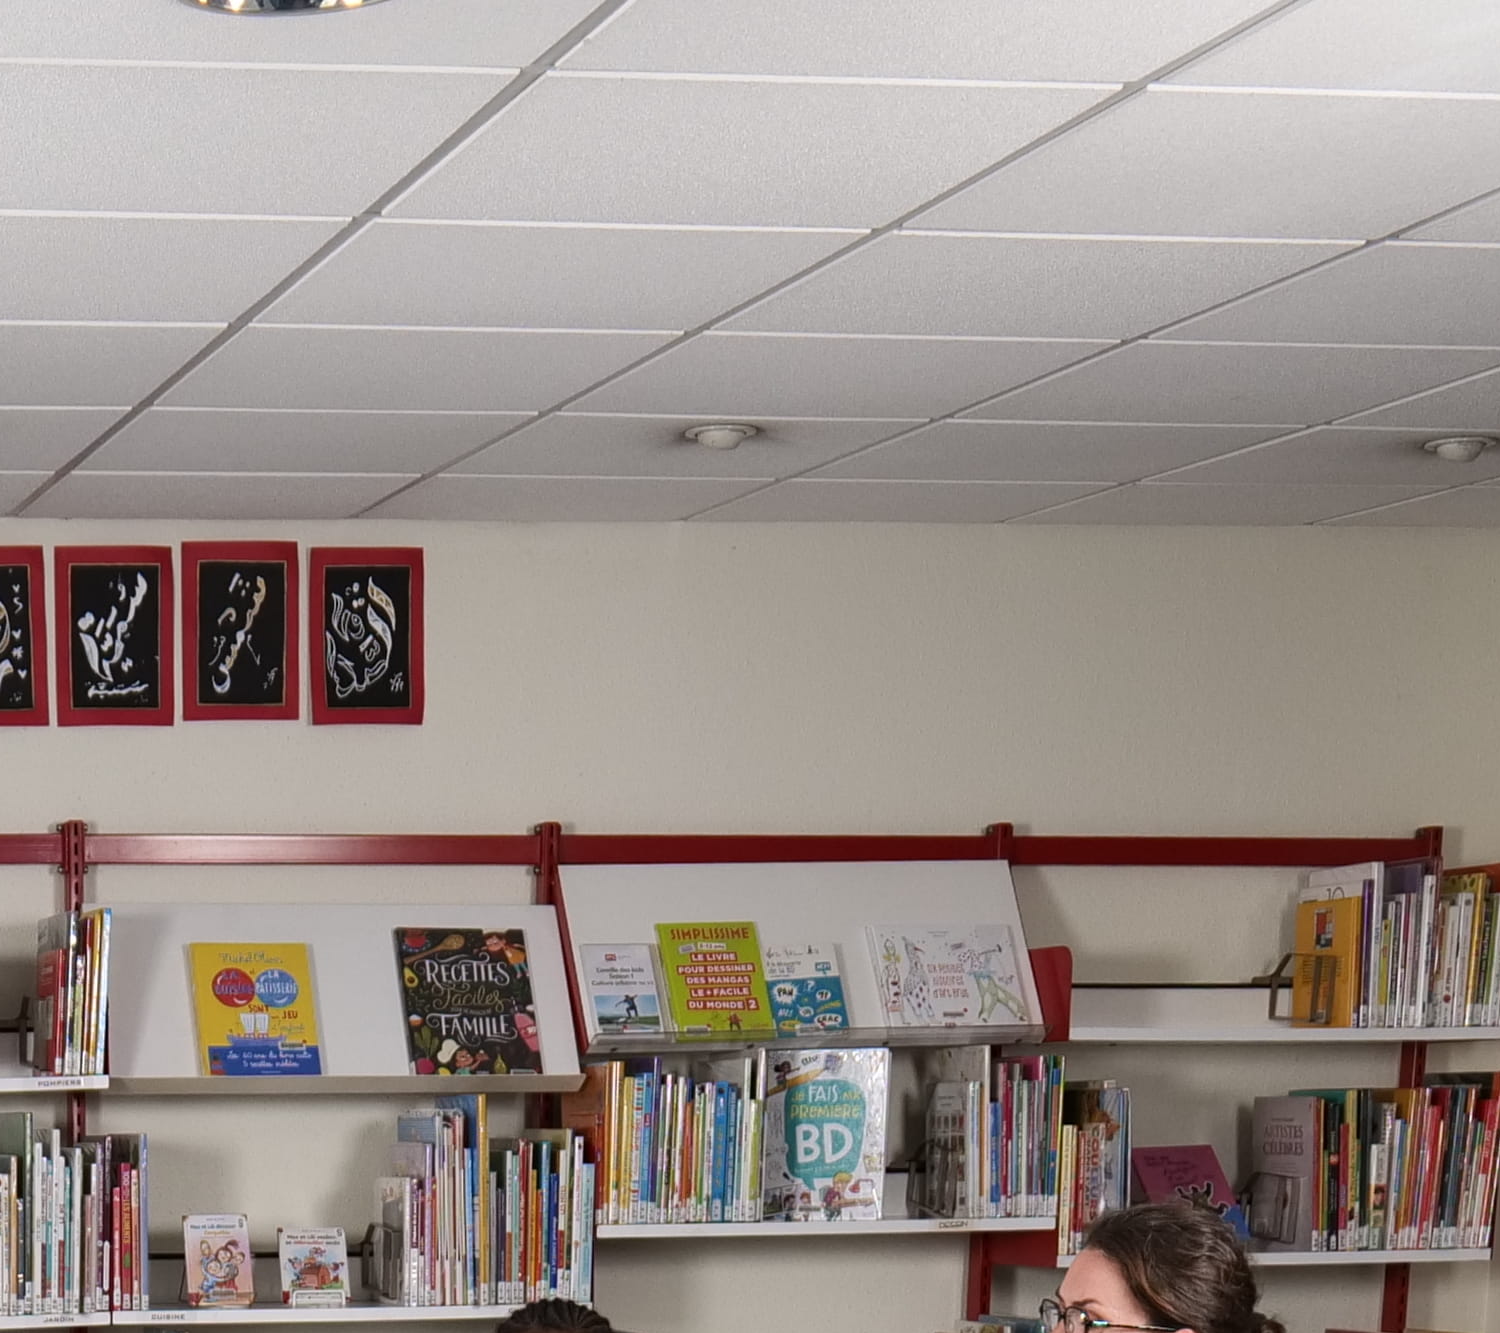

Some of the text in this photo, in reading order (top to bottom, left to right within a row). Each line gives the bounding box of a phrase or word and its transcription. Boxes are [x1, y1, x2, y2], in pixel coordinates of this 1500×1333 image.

[670, 927, 750, 940] SIMPLISSIME
[691, 952, 737, 962] LE LIVRE
[414, 955, 510, 988] RECETTES
[678, 964, 754, 974] POUR DESSINER
[267, 970, 280, 979] LA
[686, 976, 750, 985] DES MANGAS
[691, 989, 704, 997] LE
[712, 988, 750, 996] FACILE
[688, 1000, 757, 1009] DU MONDE 2
[281, 1010, 299, 1020] JEU
[426, 1013, 518, 1041] FAMILLE
[37, 1078, 82, 1087] POMPIERS
[808, 1084, 839, 1104] FAIS
[1263, 1124, 1304, 1139] ARTISTES
[795, 1122, 854, 1165] BD
[43, 1315, 75, 1323] JARDIN
[150, 1313, 186, 1321] CUISINE
